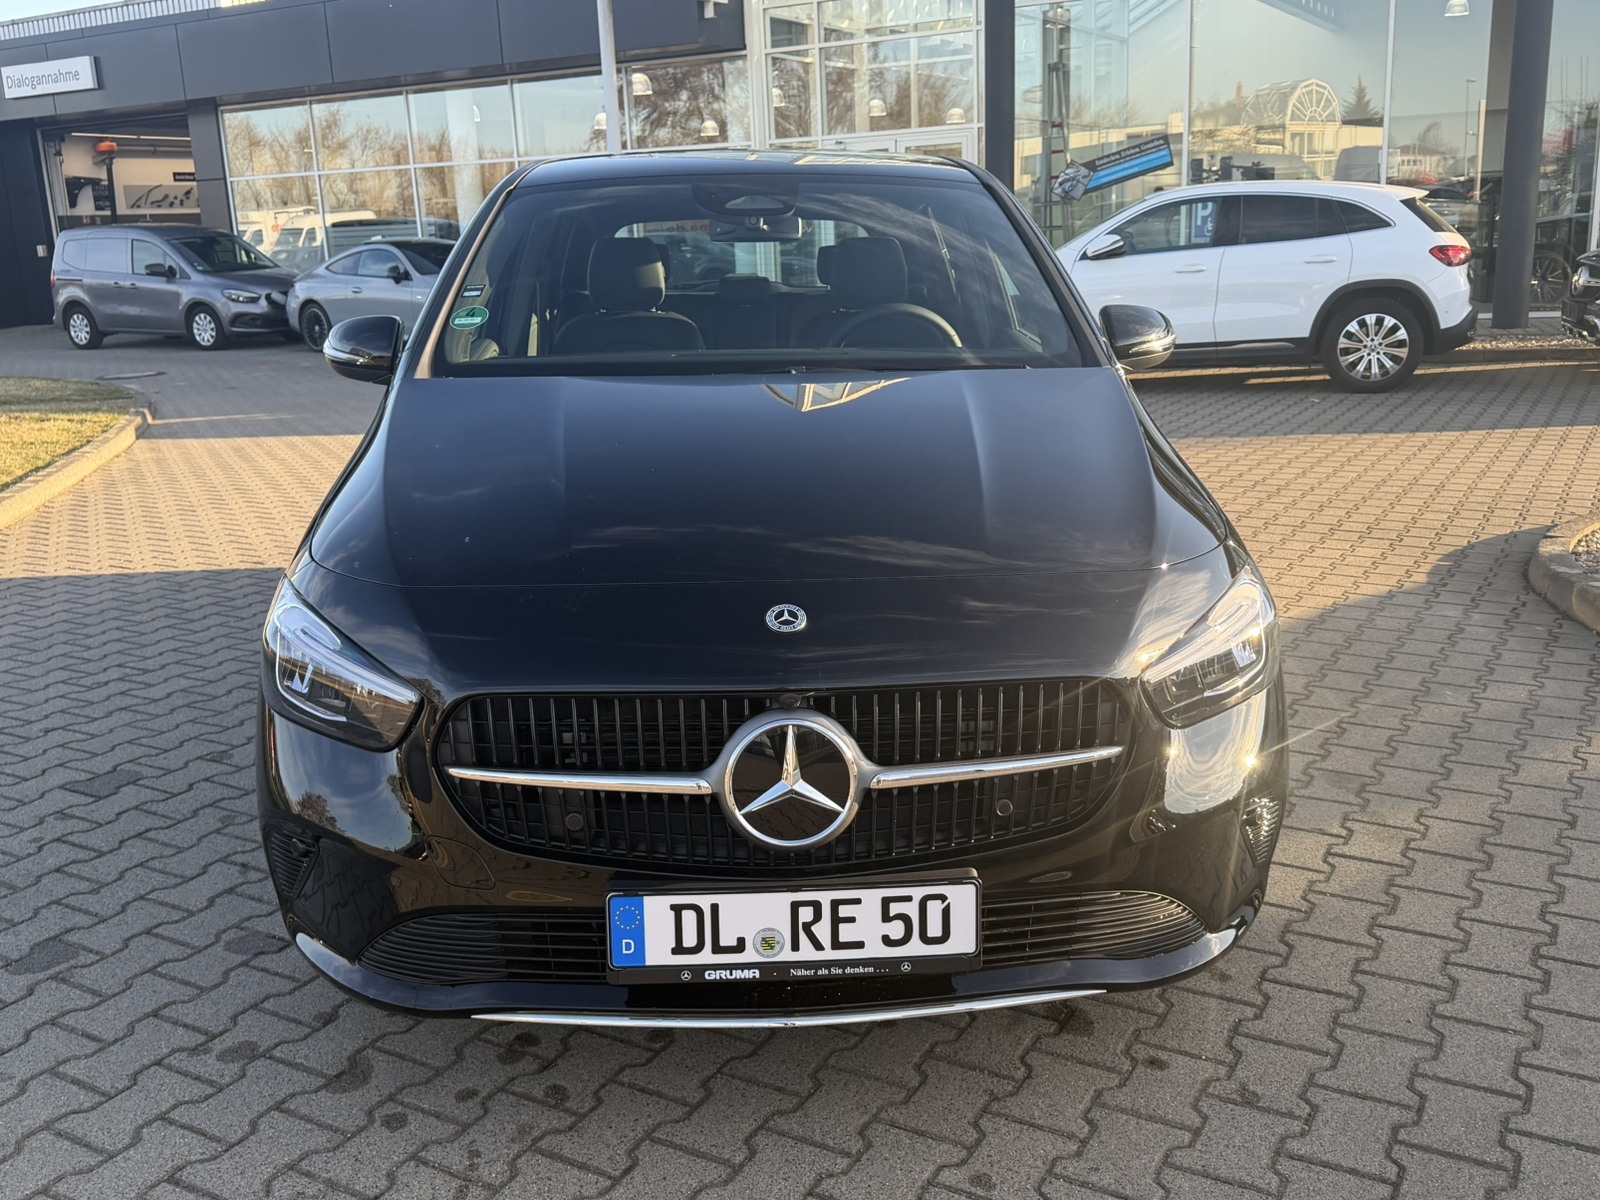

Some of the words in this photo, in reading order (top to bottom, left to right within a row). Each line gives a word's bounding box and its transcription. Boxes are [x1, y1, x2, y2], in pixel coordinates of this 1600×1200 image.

[6, 68, 80, 90] Dialogannahme
[1196, 201, 1213, 225] P
[465, 307, 476, 317] 4
[669, 902, 746, 956] DL
[790, 897, 866, 952] RE
[881, 893, 951, 948] 50
[622, 939, 635, 955] D
[704, 968, 760, 980] GRUMA
[790, 967, 815, 976] Näher
[817, 966, 829, 975] als
[830, 965, 844, 975] Sie
[844, 965, 874, 974] denken
